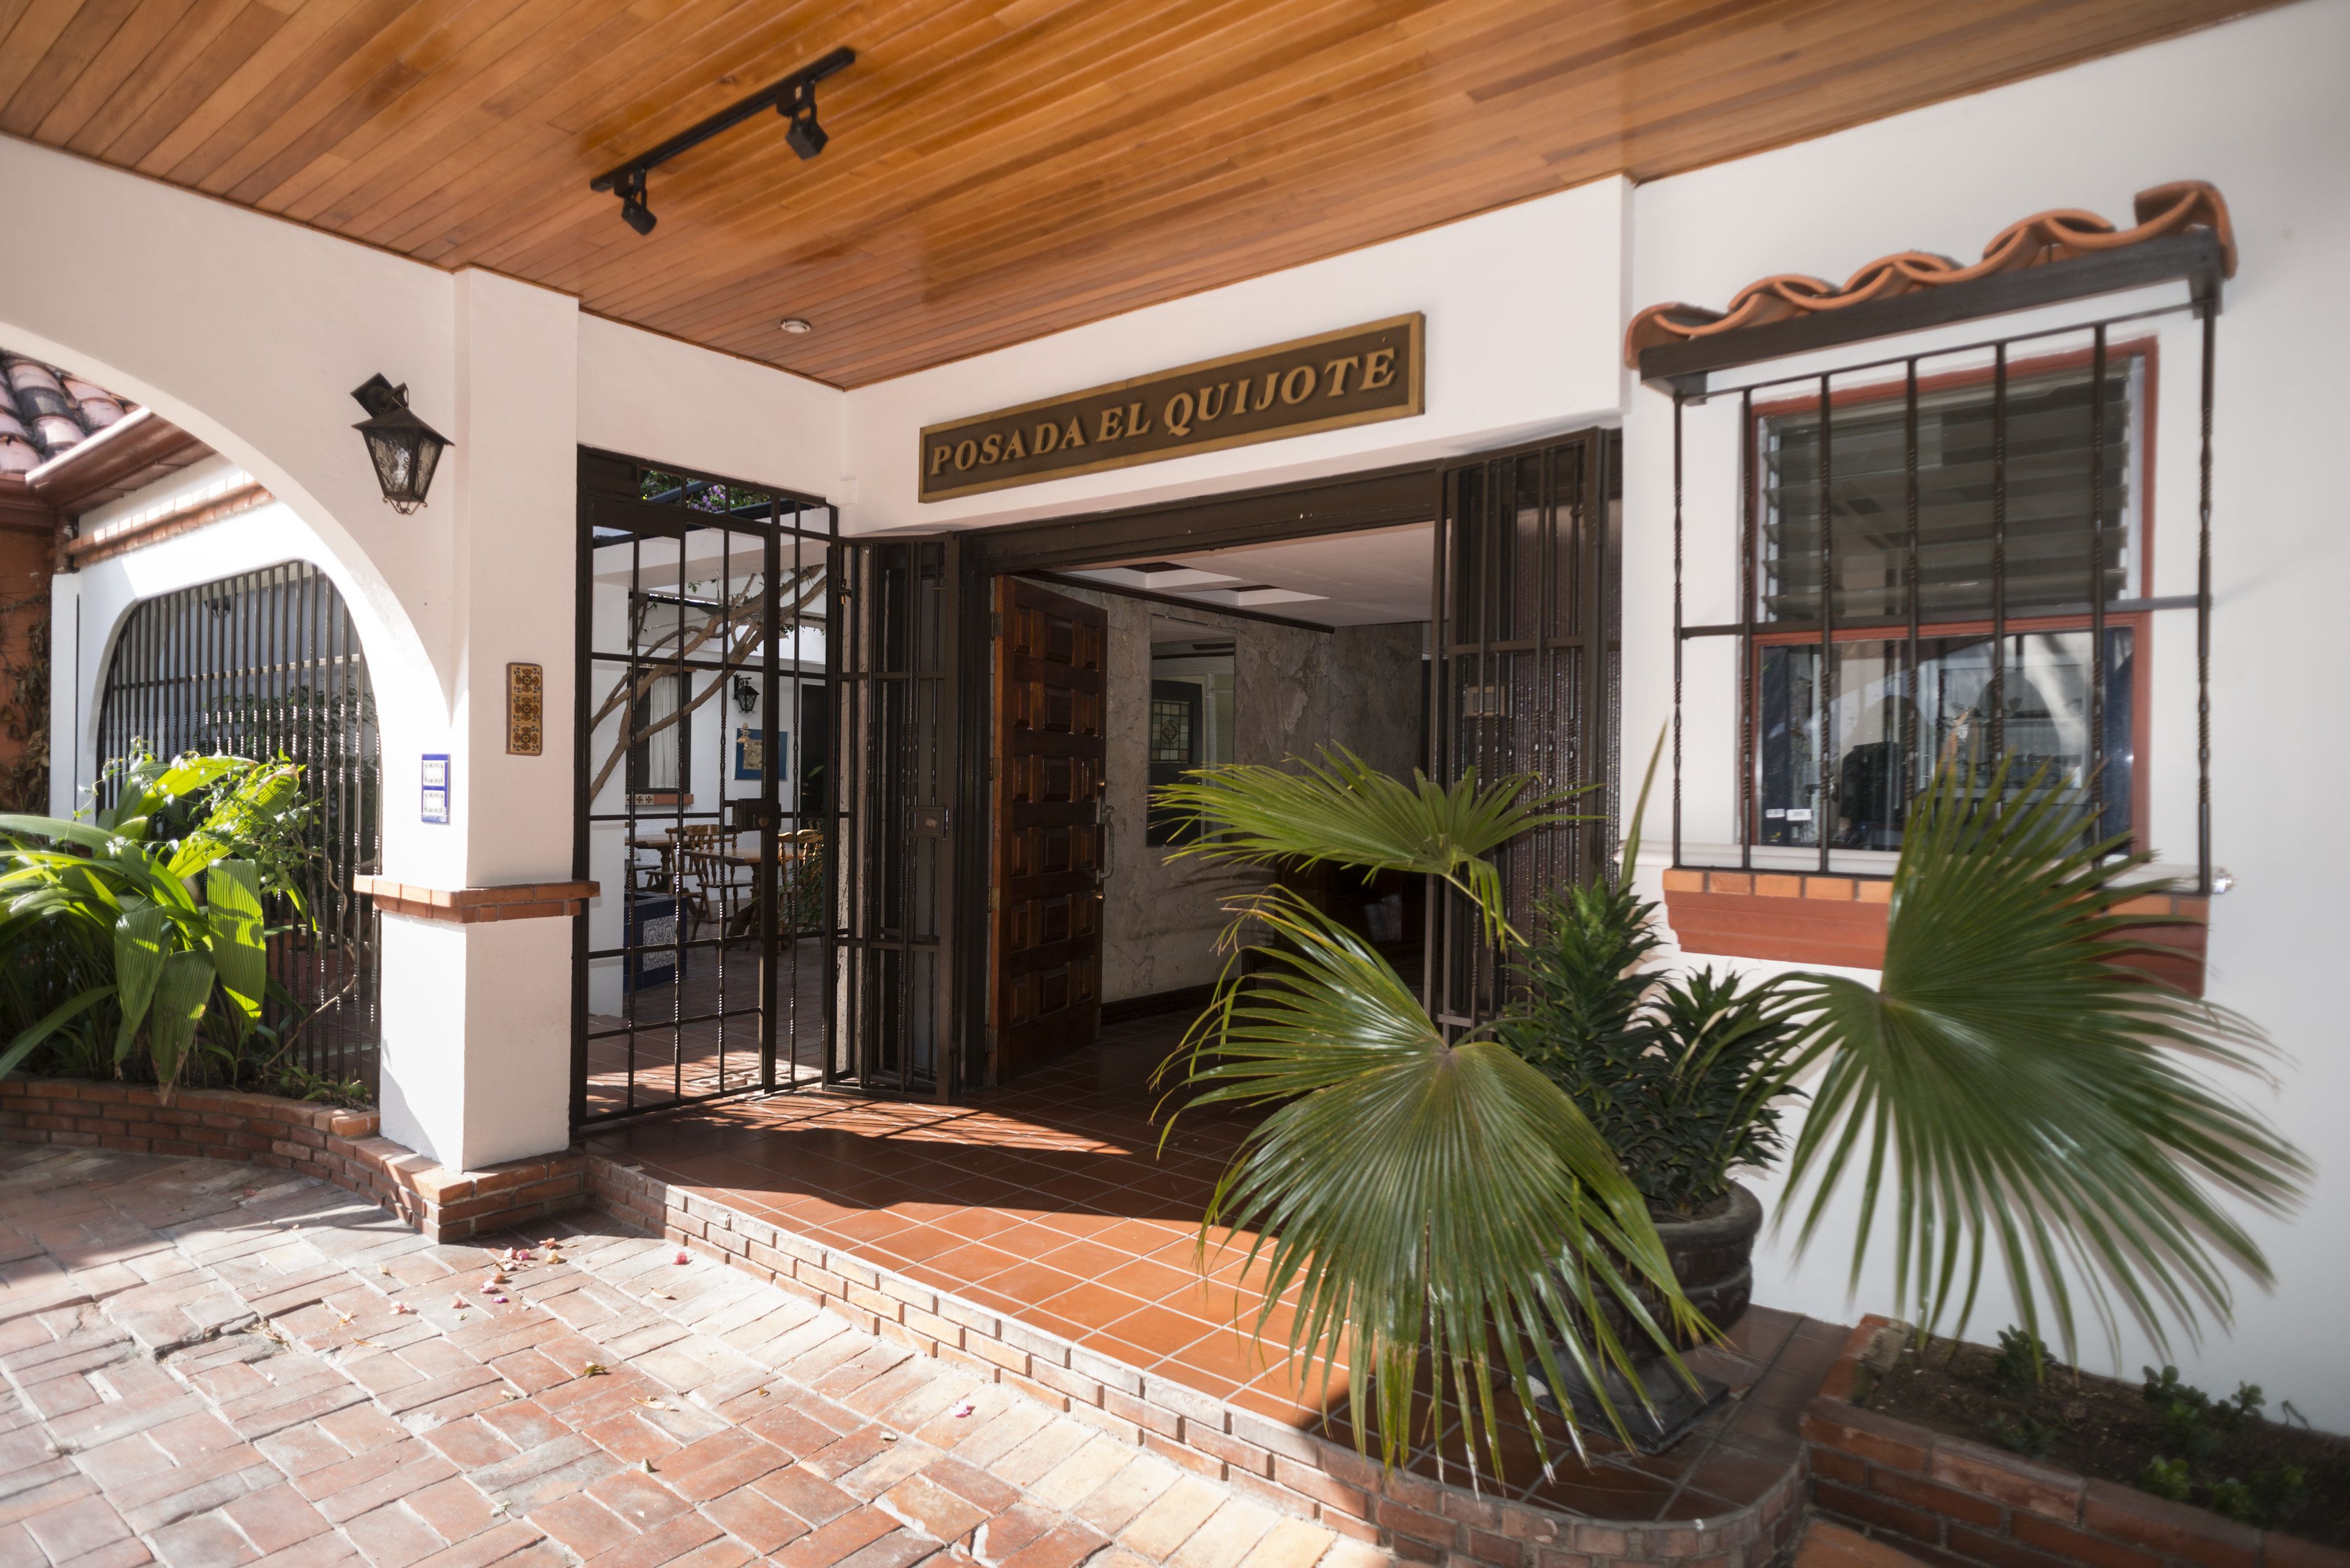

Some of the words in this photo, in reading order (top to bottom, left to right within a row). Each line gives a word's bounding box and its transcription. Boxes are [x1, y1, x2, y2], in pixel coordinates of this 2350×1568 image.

[930, 416, 1086, 475] POSADA
[1096, 402, 1152, 442] EL
[1164, 347, 1395, 436] QUIJOTE
